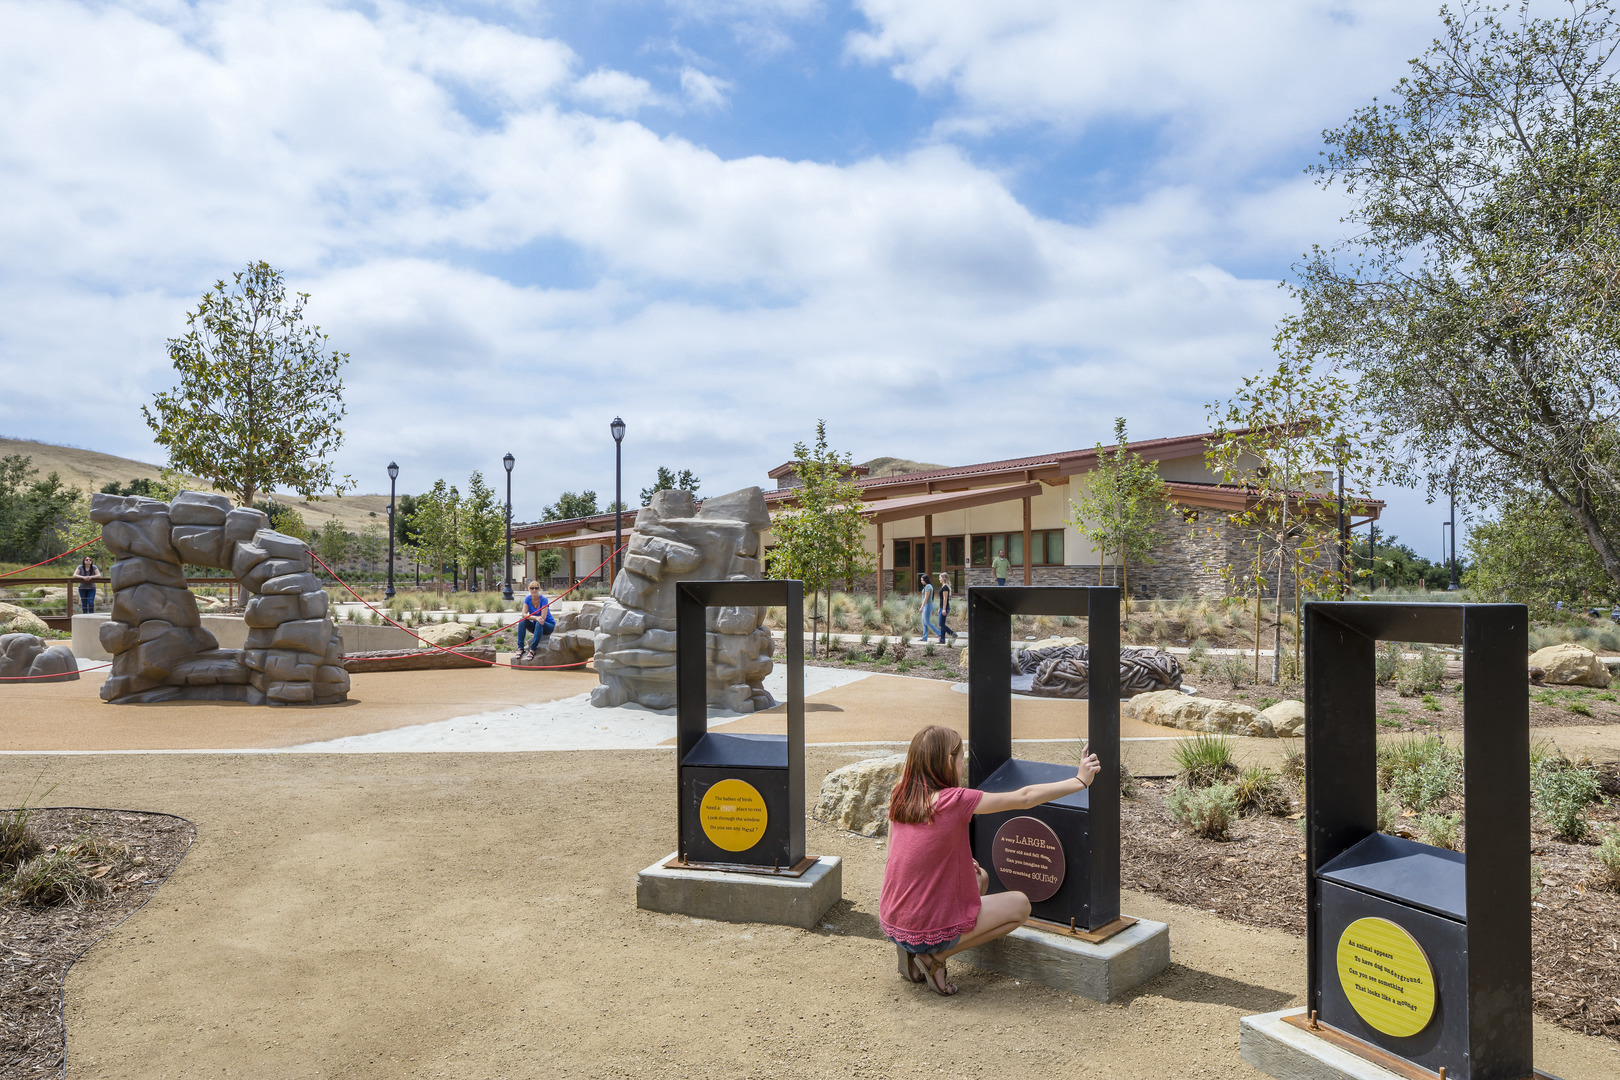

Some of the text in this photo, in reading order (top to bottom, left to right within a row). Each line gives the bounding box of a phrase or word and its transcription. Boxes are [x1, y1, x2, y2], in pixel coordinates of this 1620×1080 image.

[1016, 835, 1046, 848] LARGE
[1357, 943, 1372, 952] animal
[1374, 949, 1393, 959] appears
[1362, 958, 1373, 967] have
[1374, 963, 1383, 971] dug
[1384, 967, 1423, 984] underground.
[1378, 979, 1403, 993] something
[1355, 984, 1366, 992] That
[1367, 988, 1380, 998] looks
[1382, 993, 1391, 1002] like
[1397, 1000, 1417, 1012] mound?
